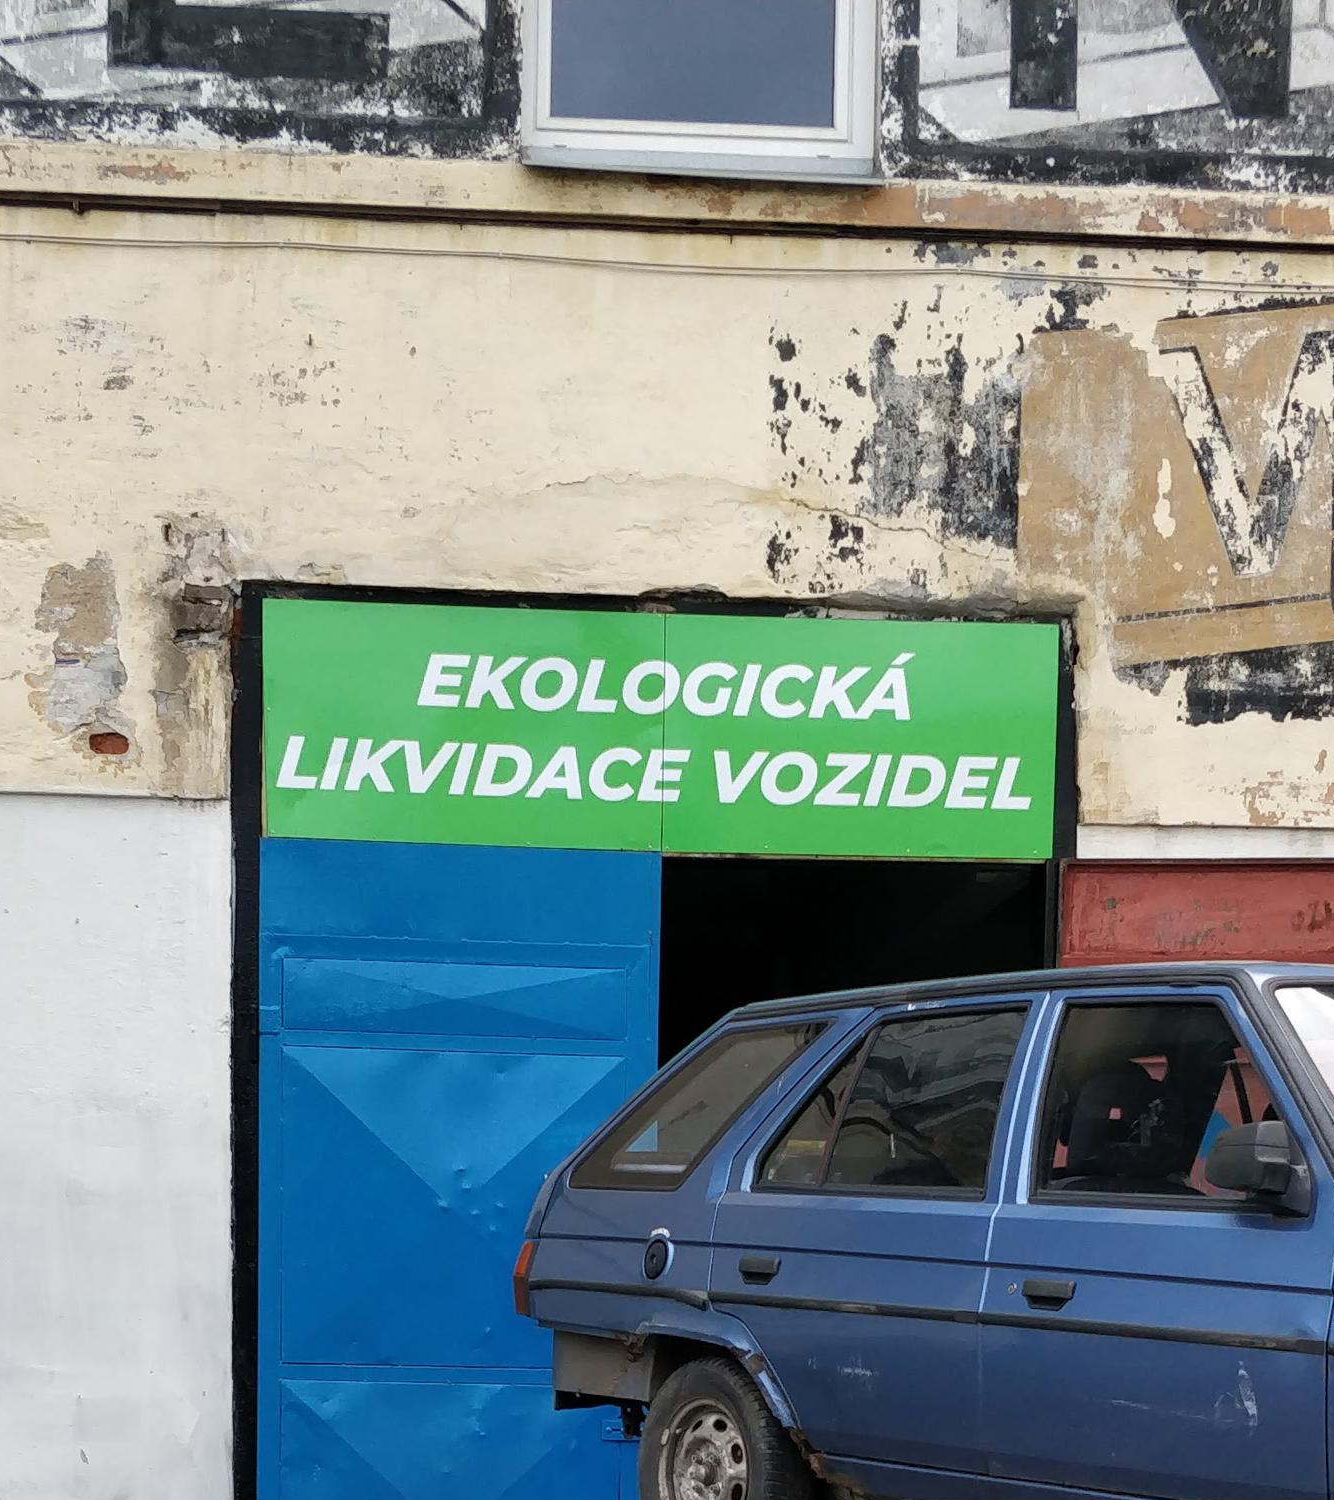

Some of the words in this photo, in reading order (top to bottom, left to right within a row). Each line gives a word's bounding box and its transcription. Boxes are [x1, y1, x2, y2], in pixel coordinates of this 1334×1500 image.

[417, 652, 915, 720] EKOLOGICKÁ
[276, 736, 691, 802] LIKVIDACE
[714, 750, 1031, 809] VOZIDEL
